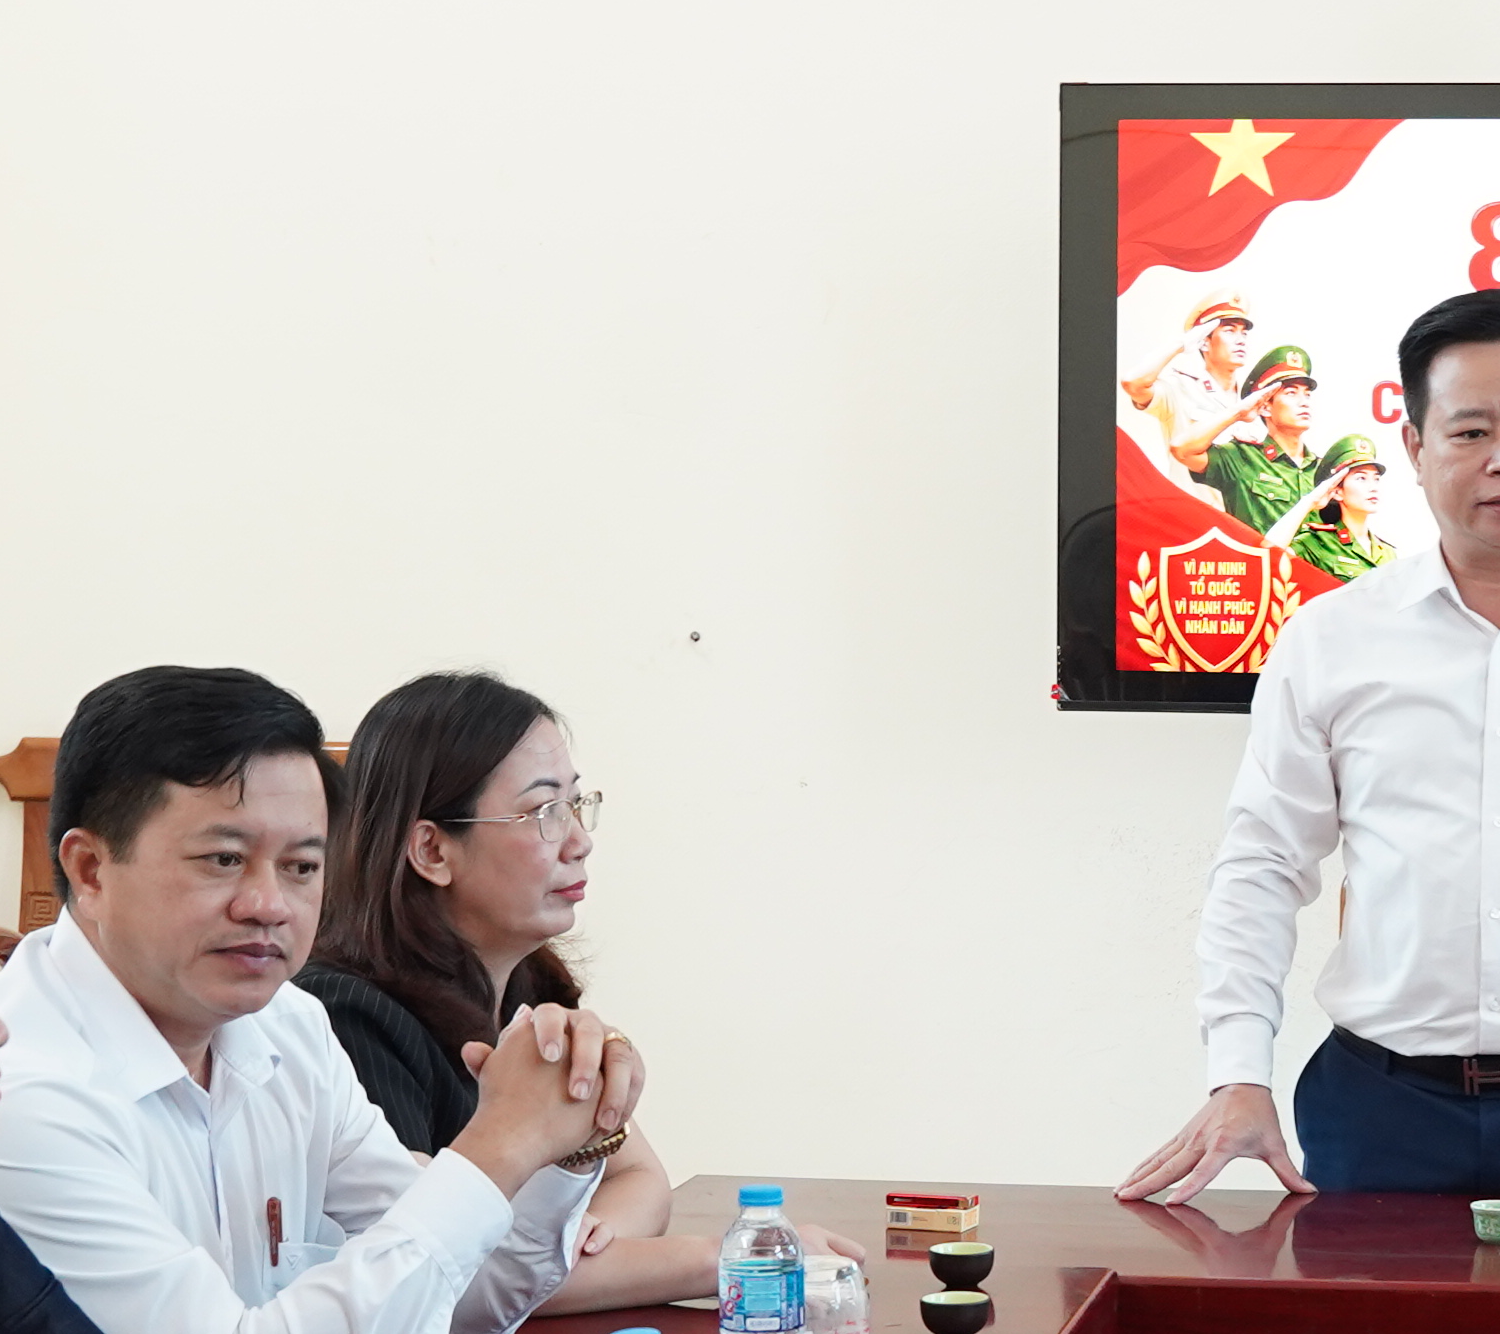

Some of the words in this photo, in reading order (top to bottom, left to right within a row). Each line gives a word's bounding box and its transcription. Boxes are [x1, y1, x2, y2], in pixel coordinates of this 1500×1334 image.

[1183, 558, 1197, 575] VÌ
[1198, 561, 1215, 575] AN
[1217, 561, 1247, 576] NINH
[1189, 576, 1206, 595] TỔ
[1207, 577, 1241, 597] QUỐC
[1174, 597, 1187, 614] VÌ
[1189, 600, 1222, 617] HẠNH
[1223, 598, 1256, 615] PHÚC
[1185, 617, 1218, 634] NHÂN
[1220, 617, 1245, 635] DÂN
